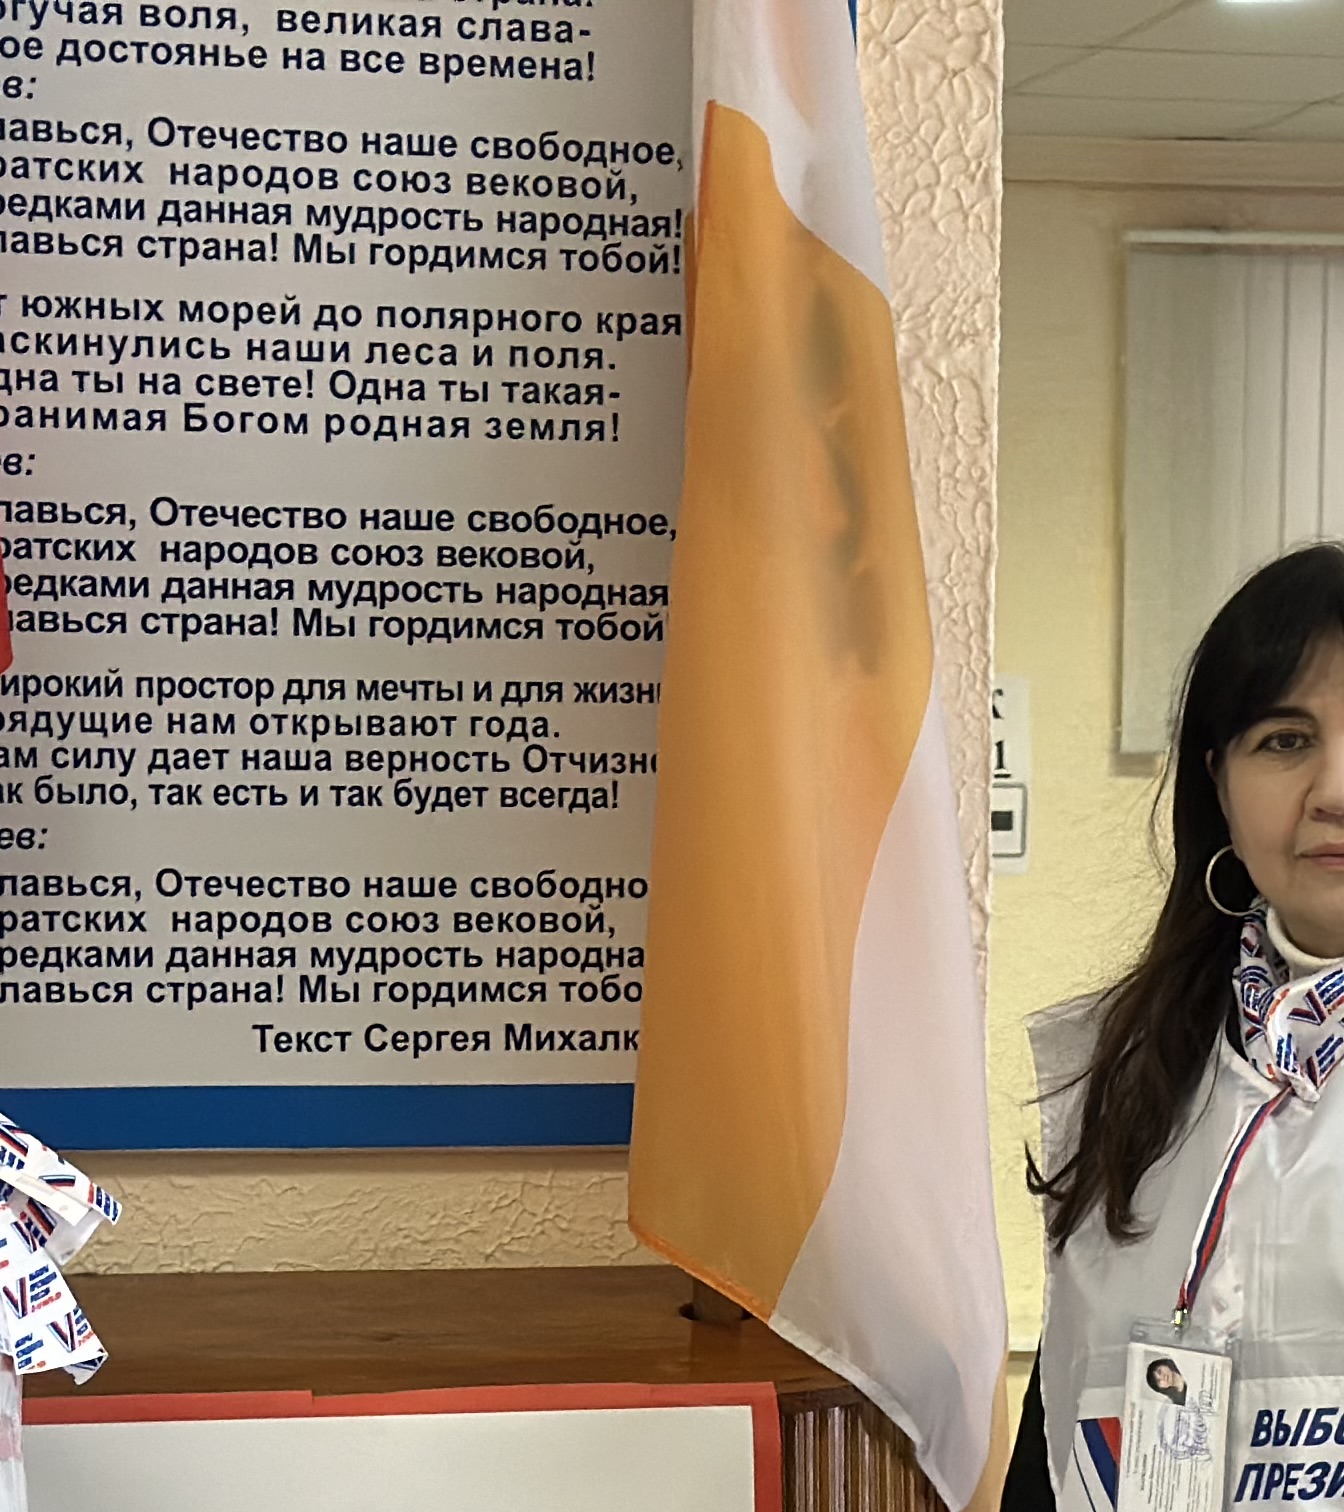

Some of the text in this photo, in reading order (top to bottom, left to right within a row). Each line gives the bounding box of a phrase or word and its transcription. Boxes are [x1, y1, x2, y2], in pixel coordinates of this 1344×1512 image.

[139, 3, 249, 37] воля,
[276, 9, 442, 39] великая
[55, 38, 268, 69] достоянье
[282, 47, 326, 71] на
[340, 49, 405, 74] все
[419, 50, 595, 84] времена!
[147, 116, 348, 154] Отечество
[361, 131, 458, 158] наше
[470, 130, 684, 172] свободное,
[169, 162, 339, 195] народов
[353, 168, 452, 195] союз
[466, 168, 638, 207] вековой,
[156, 199, 292, 228] данная
[306, 204, 484, 237] мудрость
[496, 208, 683, 247] народная!
[136, 231, 278, 268] страна!
[293, 232, 356, 265] Мы
[369, 242, 547, 275] гордимся
[559, 241, 681, 275] тобой!
[21, 294, 165, 322] южных
[178, 294, 301, 332] морей
[313, 304, 363, 332] до
[376, 305, 583, 338] полярного
[596, 312, 682, 342] края
[246, 338, 350, 363] наши
[364, 341, 458, 367] леса
[473, 344, 493, 367] и
[509, 345, 616, 370] поля.
[71, 370, 124, 394] ты
[138, 372, 181, 396] на
[195, 368, 314, 399] свете!
[328, 369, 426, 406] Одна
[438, 379, 489, 403] ты
[500, 381, 621, 406] такая-
[183, 402, 308, 435] Богом
[324, 413, 470, 444] родная
[484, 412, 619, 443] земля!
[149, 496, 347, 530] Отечество
[359, 508, 455, 532] наше
[467, 503, 677, 542] свободное,
[0, 537, 594, 576] атских народов союз вековой,
[3, 573, 669, 613] едками данная мудрость народная
[7, 606, 669, 647] авься страна! Мы гордимся тобой
[135, 676, 275, 708] простор
[282, 678, 346, 706] для
[356, 679, 464, 702] мечты
[473, 680, 493, 703] и
[500, 681, 564, 708] для
[573, 681, 661, 704] жизн
[167, 712, 236, 735] нам
[249, 713, 458, 744] открывают
[469, 715, 560, 743] года.
[50, 746, 137, 778] силу
[147, 748, 230, 776] дает
[241, 748, 332, 772] наша
[345, 749, 511, 780] верность
[522, 743, 658, 775] Отчизн
[34, 774, 138, 811] было,
[147, 783, 203, 806] так
[213, 784, 288, 807] есть
[300, 784, 319, 807] и
[329, 785, 383, 807] так
[393, 777, 490, 815] будет
[500, 779, 619, 814] всегда!
[155, 867, 351, 899] Отечество
[363, 876, 458, 899] наше
[470, 868, 649, 904] свободно
[171, 910, 333, 941] народов
[345, 911, 440, 934] союз
[453, 903, 615, 939] вековой,
[165, 946, 297, 974] данная
[310, 946, 484, 976] мудрость
[496, 946, 645, 975] народна
[146, 974, 284, 1011] страна!
[299, 974, 360, 1003] Мы
[373, 981, 547, 1011] гордимся
[558, 973, 643, 1003] тобо
[251, 1022, 640, 1060] Текст Сергея Михалк
